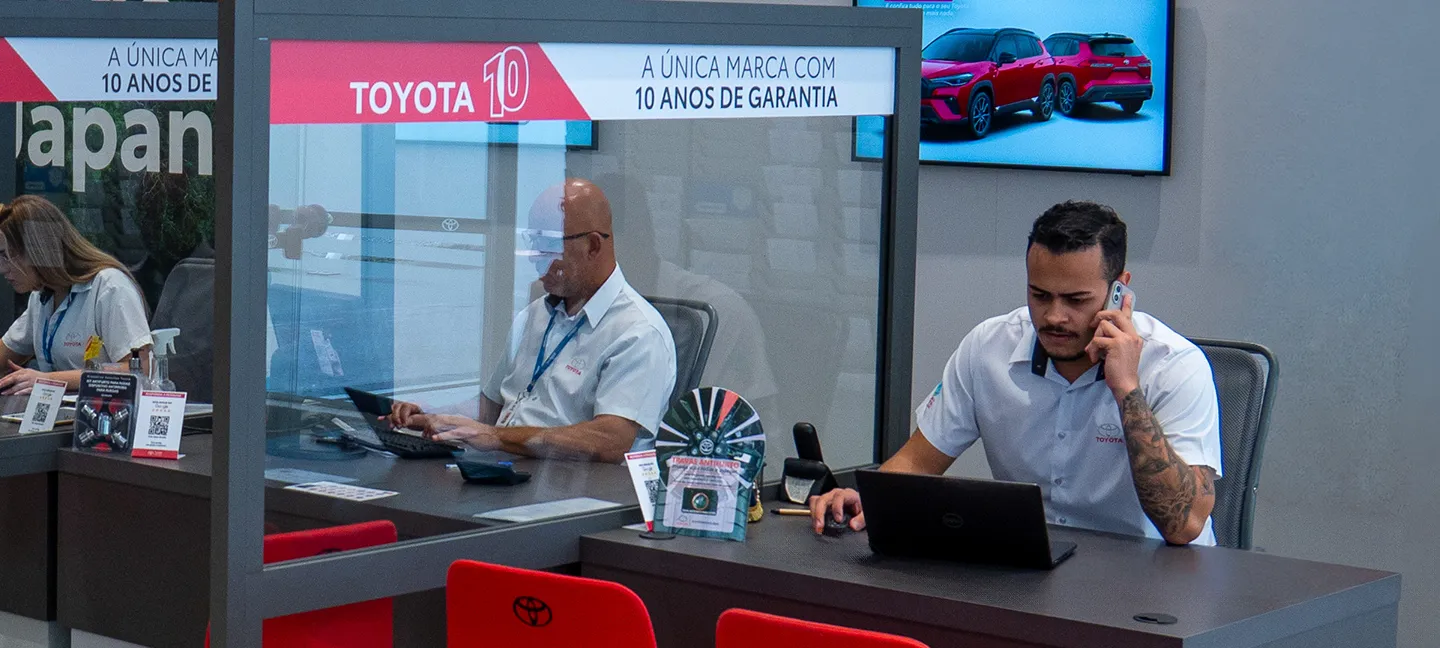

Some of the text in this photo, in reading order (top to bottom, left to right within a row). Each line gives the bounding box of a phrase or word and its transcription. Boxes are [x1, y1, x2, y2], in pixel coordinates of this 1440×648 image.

[107, 47, 121, 67] A
[127, 41, 188, 67] ÚNICA
[641, 48, 836, 79] A ÚNICA MARCA COM
[101, 73, 212, 93] 10 ANOS DE
[349, 45, 530, 118] TOYOTA 10
[635, 85, 839, 110] 10 ANOS DE GARANTIA
[672, 457, 698, 465] TRAVAS
